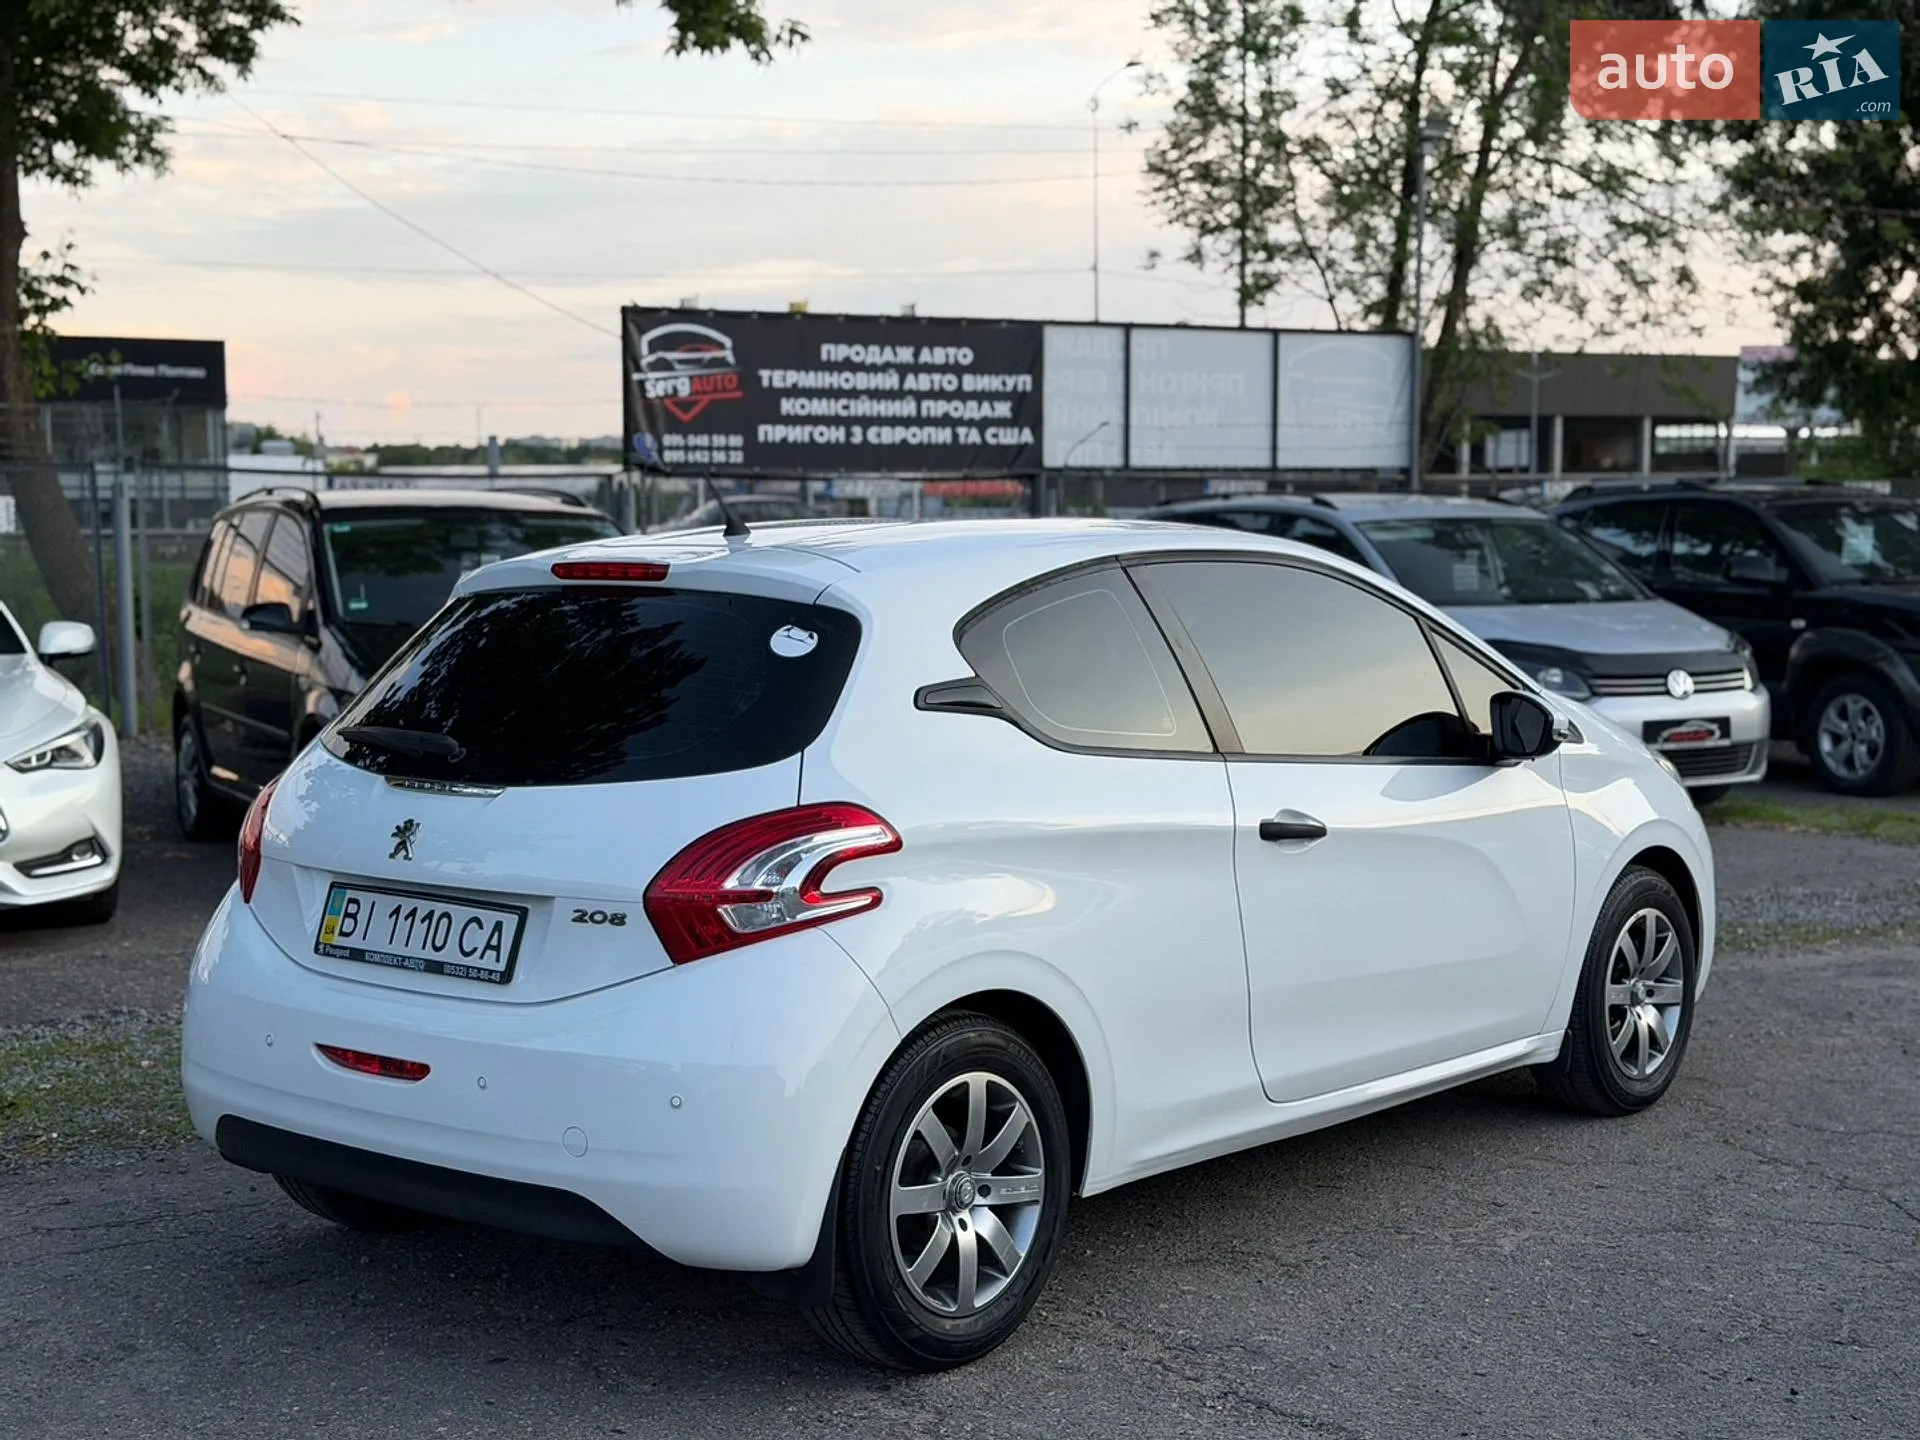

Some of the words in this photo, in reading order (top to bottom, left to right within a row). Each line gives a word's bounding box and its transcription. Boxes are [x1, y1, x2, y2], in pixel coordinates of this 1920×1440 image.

[821, 343, 915, 366] ПРОДАЖ
[918, 345, 974, 366] АВТО
[758, 367, 899, 390] ТЕРМІНОВИЙ
[903, 372, 958, 392] АВТО
[962, 373, 1032, 393] ВИКУП
[780, 394, 917, 418] КОМІСІЙНИЙ
[920, 399, 1012, 421] ПРОДАЖ
[758, 423, 845, 444] ПРИГОН
[866, 425, 953, 445] ЄВРОПИ
[955, 426, 982, 445] ТА
[985, 426, 1035, 446] США
[571, 908, 627, 926] 208
[338, 897, 376, 941] BI
[388, 904, 452, 953] 1110
[458, 916, 504, 963] CA
